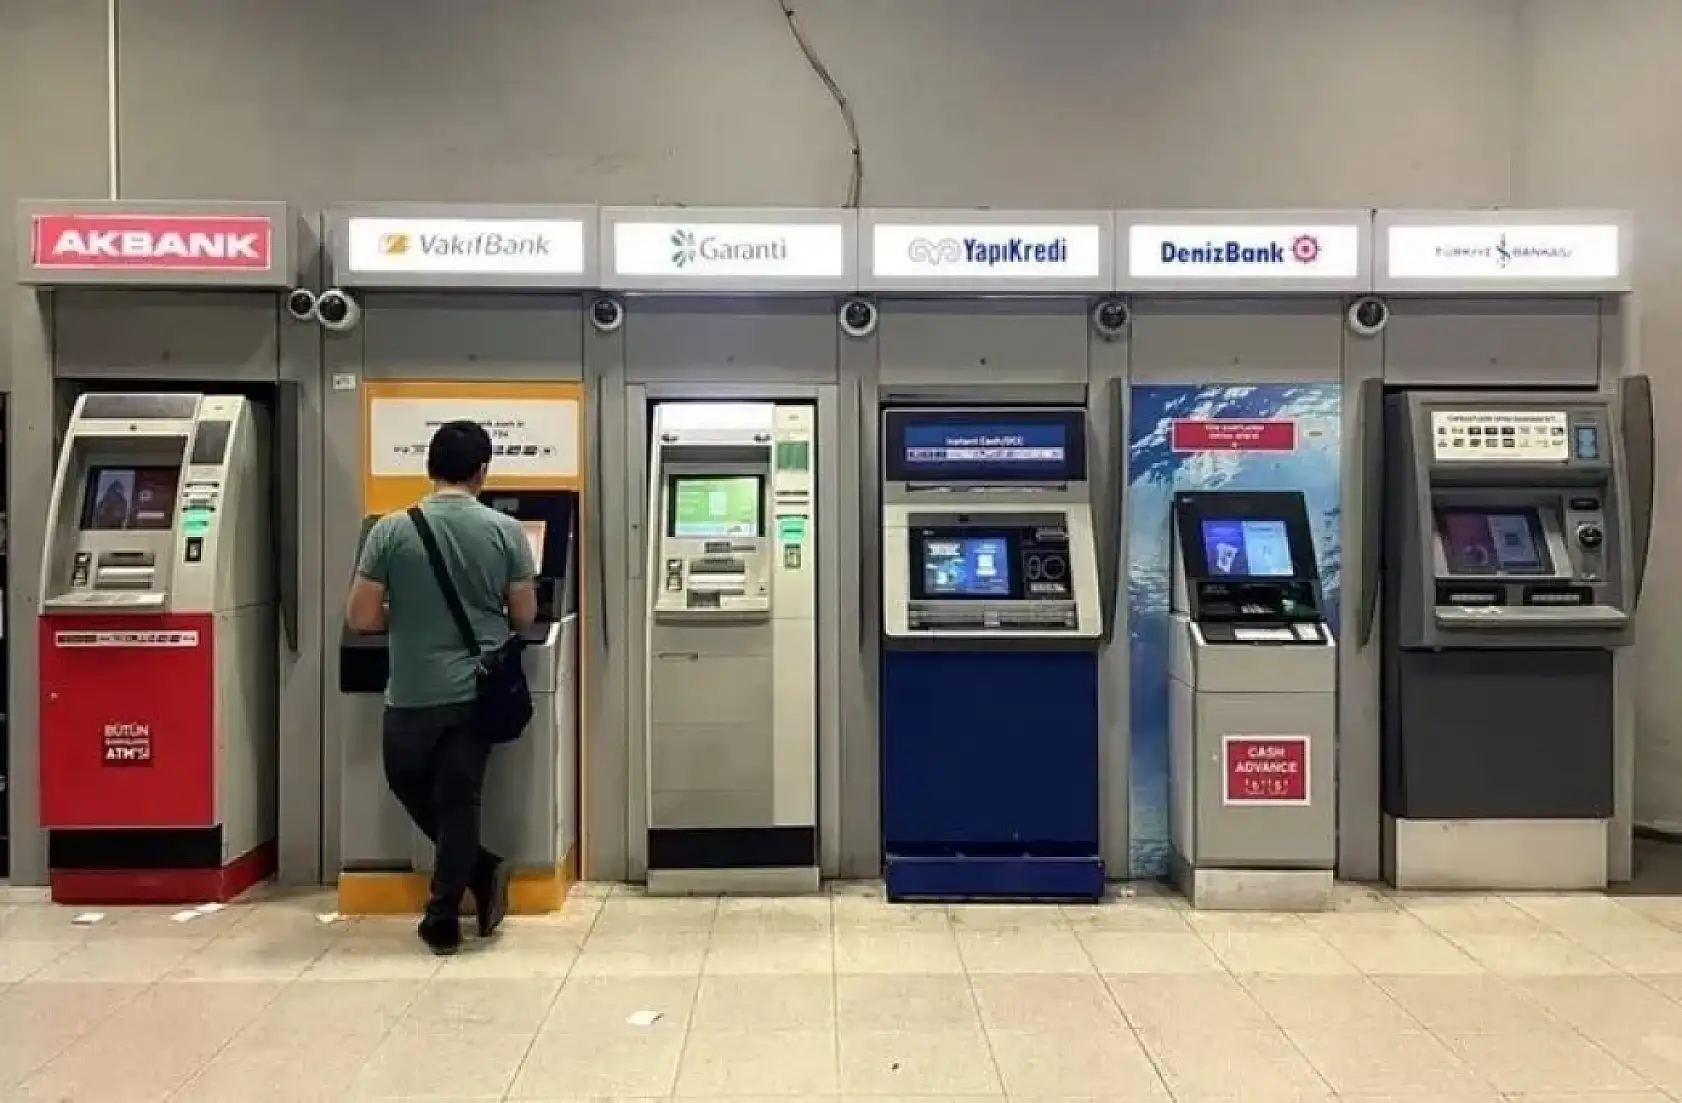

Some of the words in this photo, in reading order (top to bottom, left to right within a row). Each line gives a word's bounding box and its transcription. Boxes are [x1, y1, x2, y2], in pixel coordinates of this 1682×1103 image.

[51, 229, 260, 258] AKBANK
[700, 236, 787, 260] Garanti
[963, 237, 1068, 267] YapıKredi
[1160, 240, 1286, 263] DenizBank
[1247, 746, 1286, 757] CASH
[1234, 761, 1298, 773] ADVANCE
